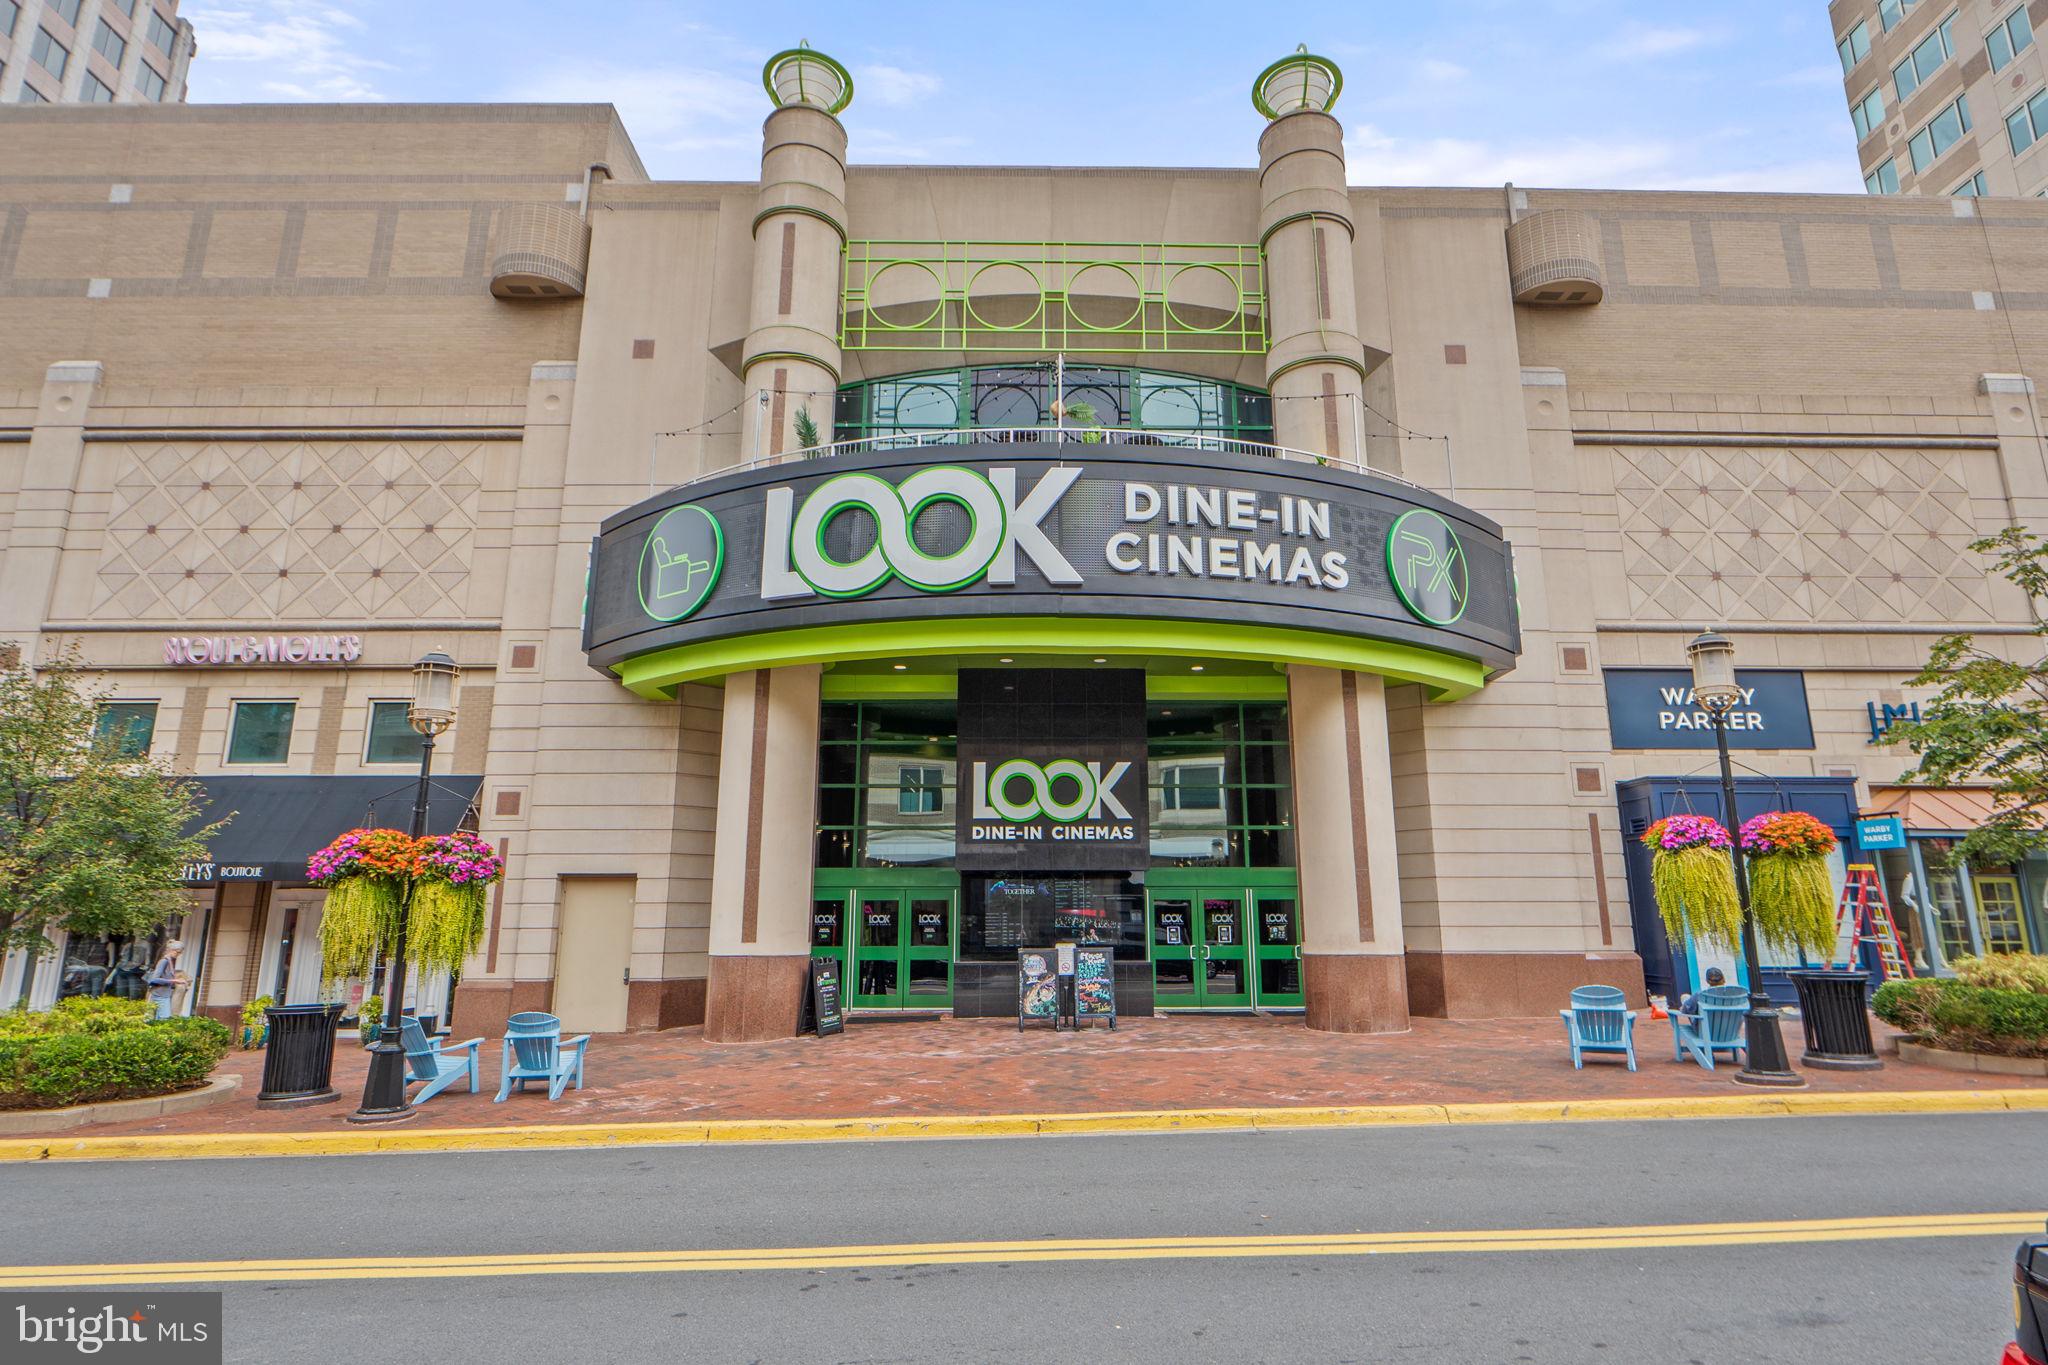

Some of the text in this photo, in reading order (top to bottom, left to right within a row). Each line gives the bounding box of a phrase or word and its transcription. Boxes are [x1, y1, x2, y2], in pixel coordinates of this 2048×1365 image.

[1125, 483, 1330, 540] DINE-IN
[761, 465, 1084, 601] LOOK
[1106, 532, 1349, 590] CINEMAS
[162, 636, 239, 664] SCOUT
[258, 635, 362, 663] MOLLY'S
[972, 758, 1133, 822] LOOK
[972, 826, 1134, 840] DINE-IN CINEMAS
[1863, 825, 1891, 833] WARBY
[1863, 834, 1894, 842] PARKER
[220, 866, 263, 878] BOUTIQUE
[1004, 888, 1036, 896] TOGETHER
[814, 914, 836, 924] LOOK
[868, 914, 891, 924] LOOK
[918, 914, 941, 924] LOOK
[1161, 913, 1184, 923] LOOK
[1211, 913, 1234, 923] LOOK
[1265, 913, 1288, 923] LOOK
